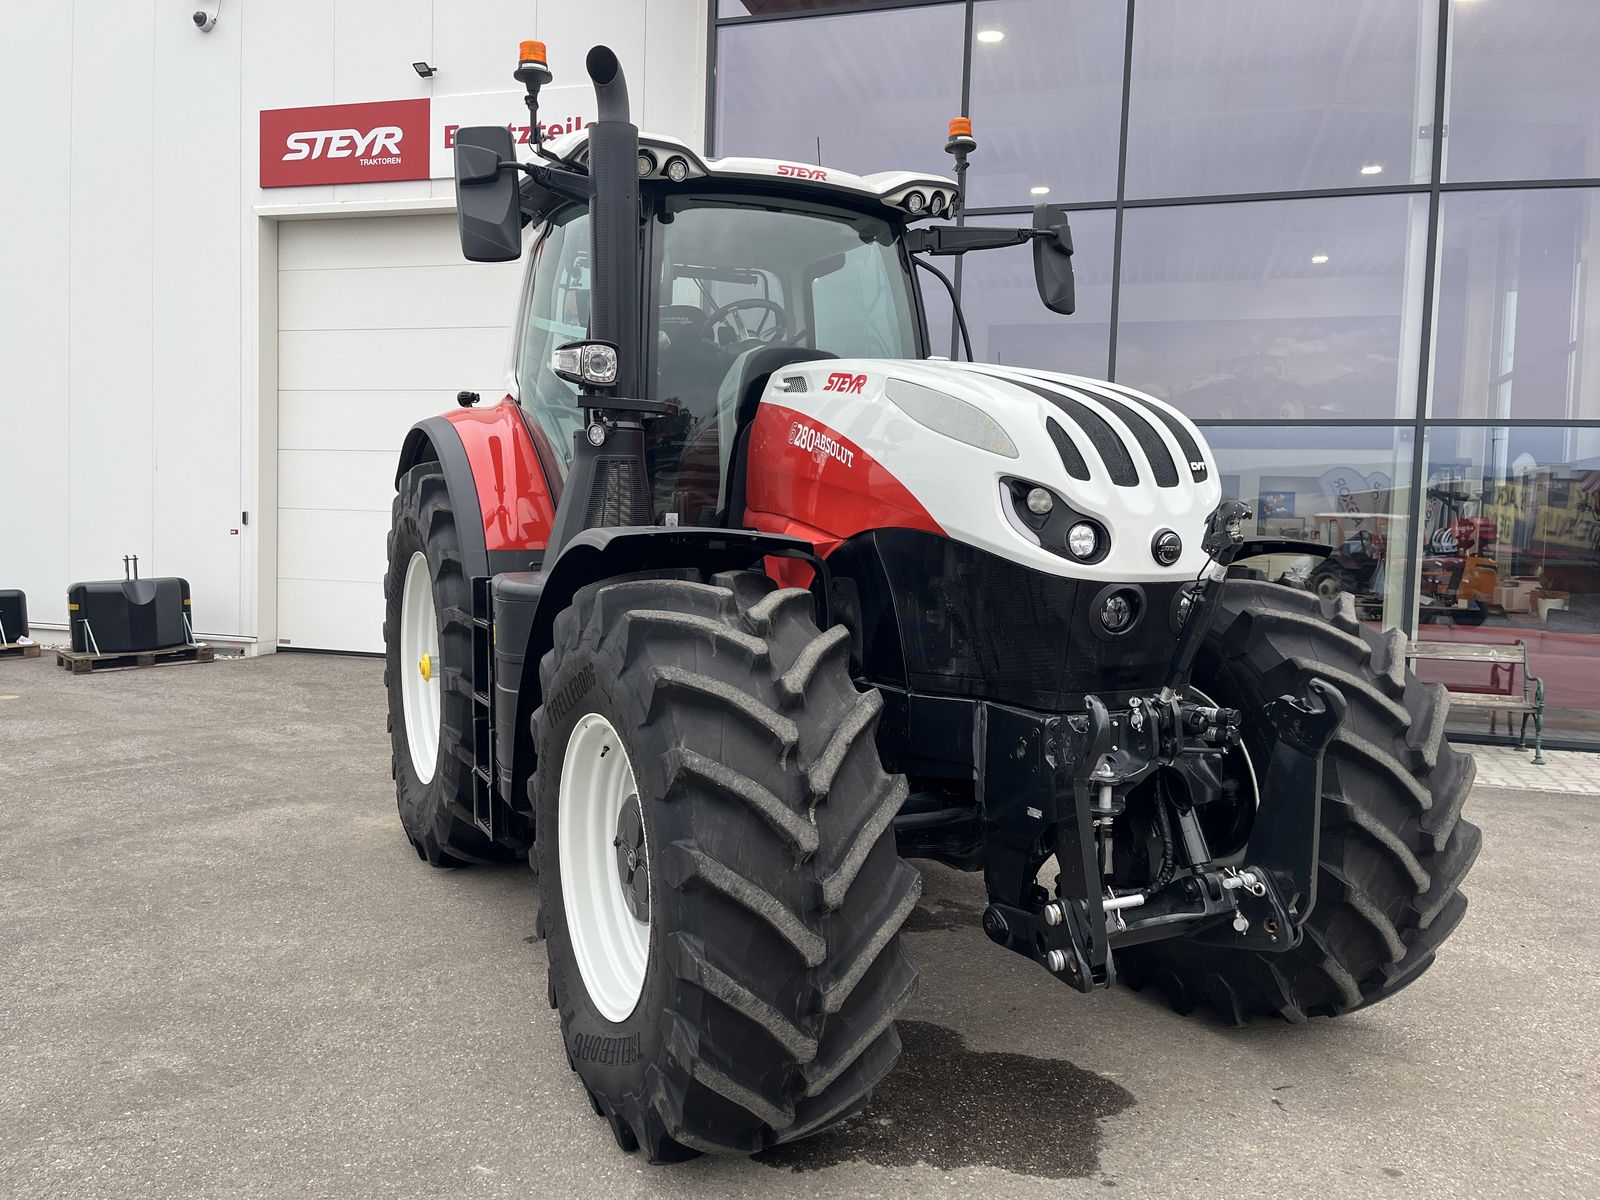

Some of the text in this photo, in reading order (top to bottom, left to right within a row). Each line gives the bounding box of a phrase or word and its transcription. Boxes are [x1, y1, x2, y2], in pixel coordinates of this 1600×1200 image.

[282, 125, 403, 162] STEYR
[359, 156, 402, 167] TRAKTOREN
[777, 165, 827, 181] STEYR
[823, 372, 868, 394] STEYR
[814, 432, 854, 468] ABSOLUT
[1190, 461, 1206, 471] CVT
[546, 662, 597, 729] TRELLEBORG
[573, 1032, 644, 1066] TRELLEBORG
